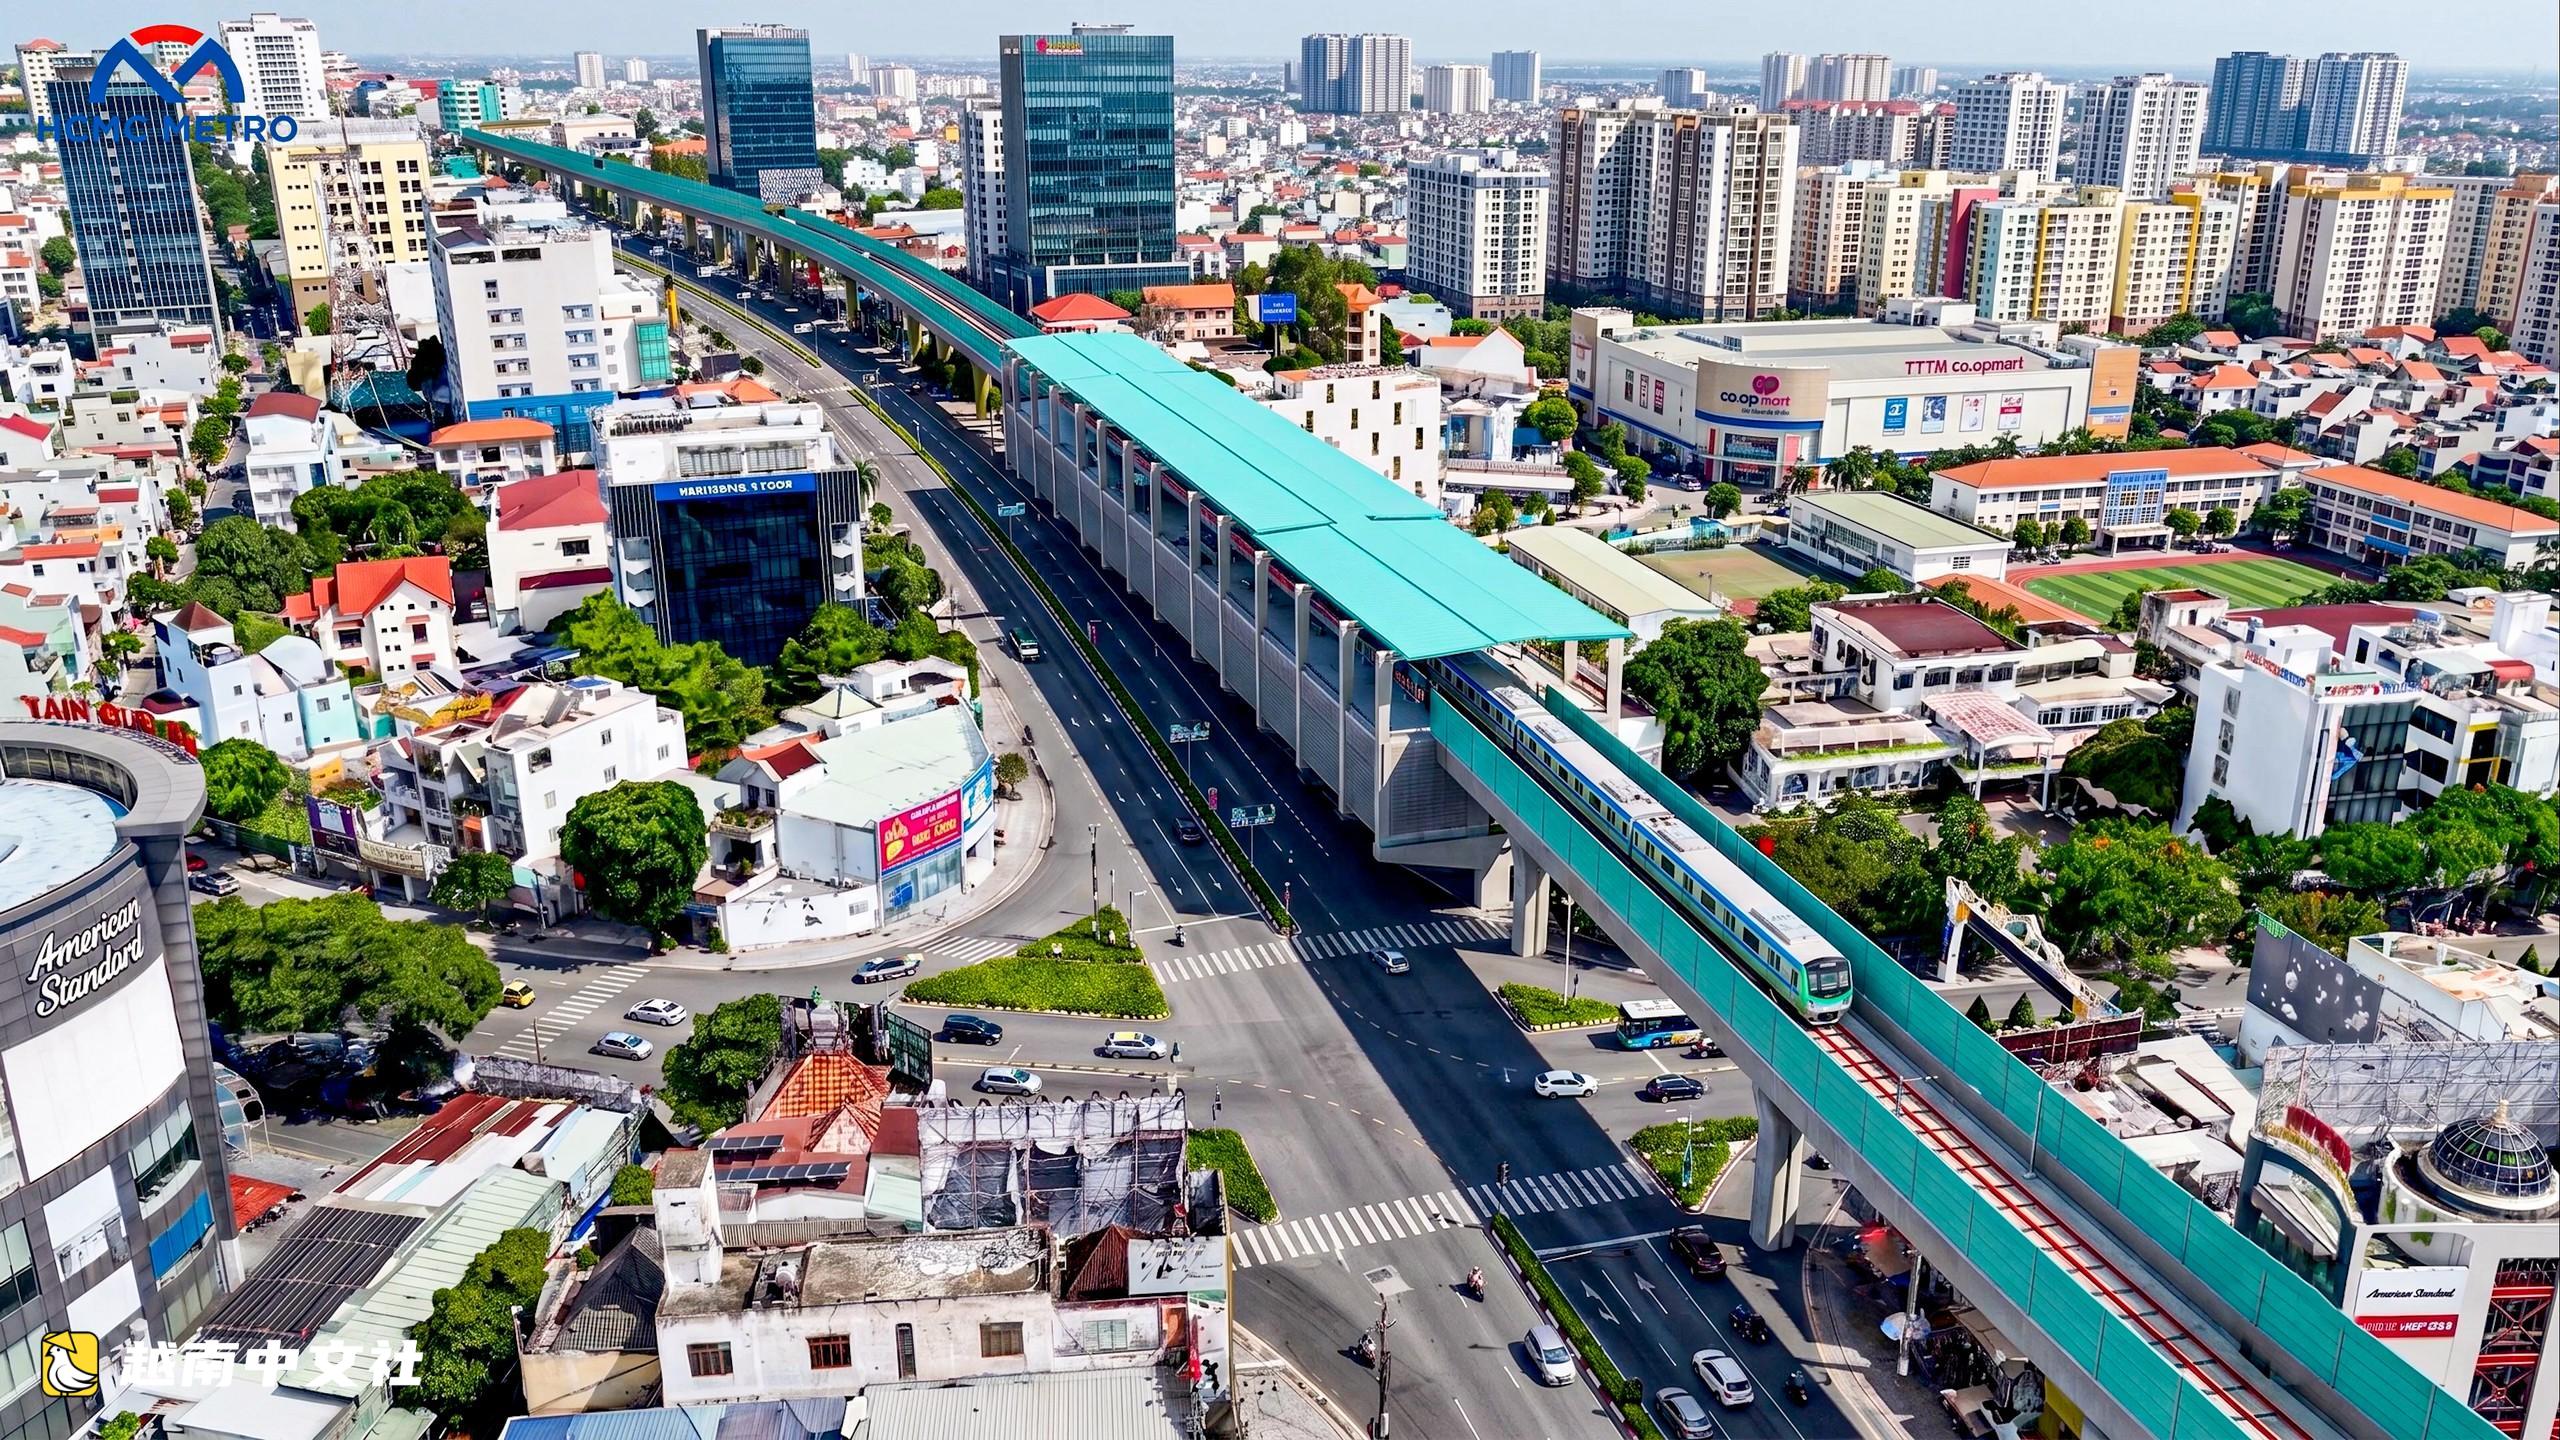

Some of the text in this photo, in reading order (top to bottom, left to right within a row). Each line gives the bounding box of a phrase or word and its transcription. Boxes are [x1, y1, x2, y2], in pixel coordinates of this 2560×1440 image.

[1905, 356, 2024, 375] TTTM co.opmart
[1720, 391, 1791, 407] co.op mart
[26, 897, 142, 984] American
[36, 922, 145, 1017] Standard
